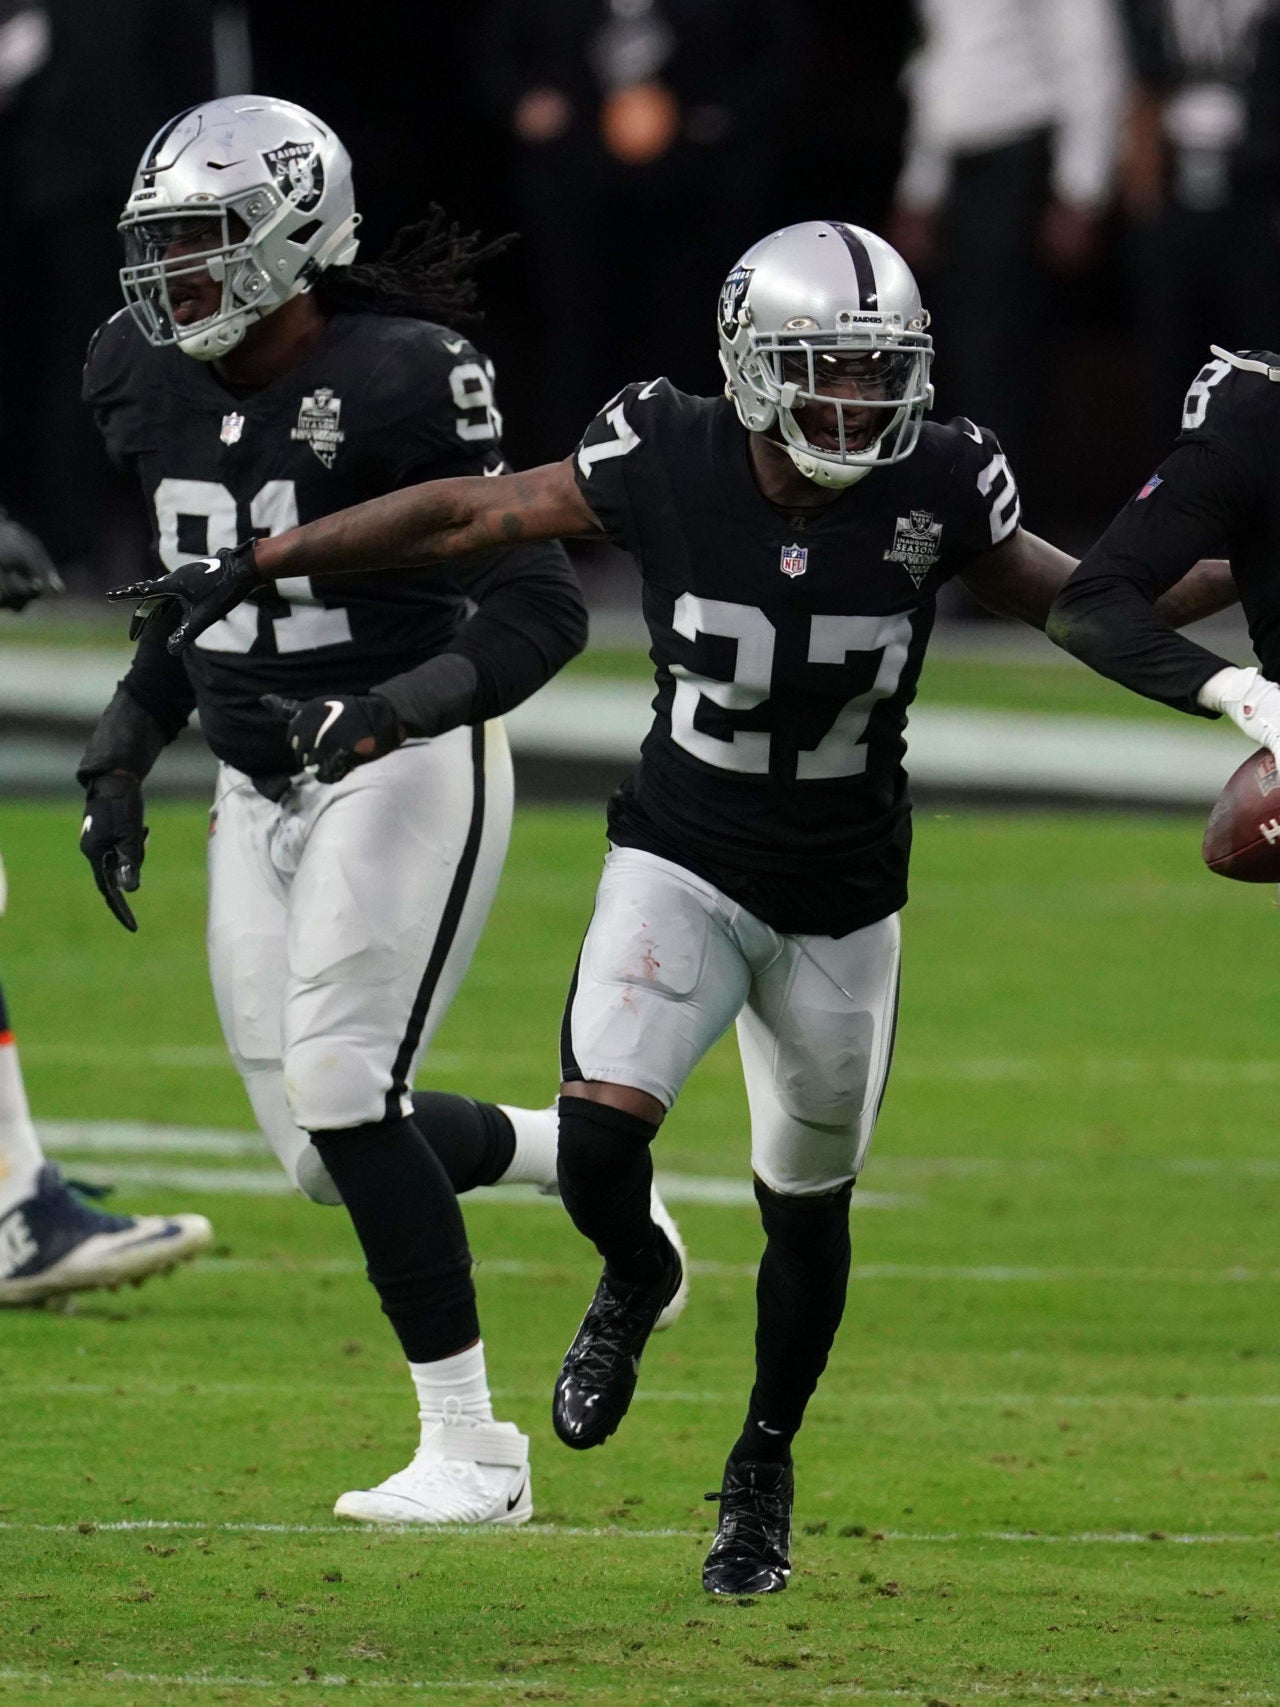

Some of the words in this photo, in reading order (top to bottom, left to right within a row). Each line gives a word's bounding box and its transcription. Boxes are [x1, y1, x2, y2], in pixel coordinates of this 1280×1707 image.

[853, 316, 882, 324] RAIDERS
[896, 543, 934, 554] SEASON
[669, 592, 918, 780] 27
